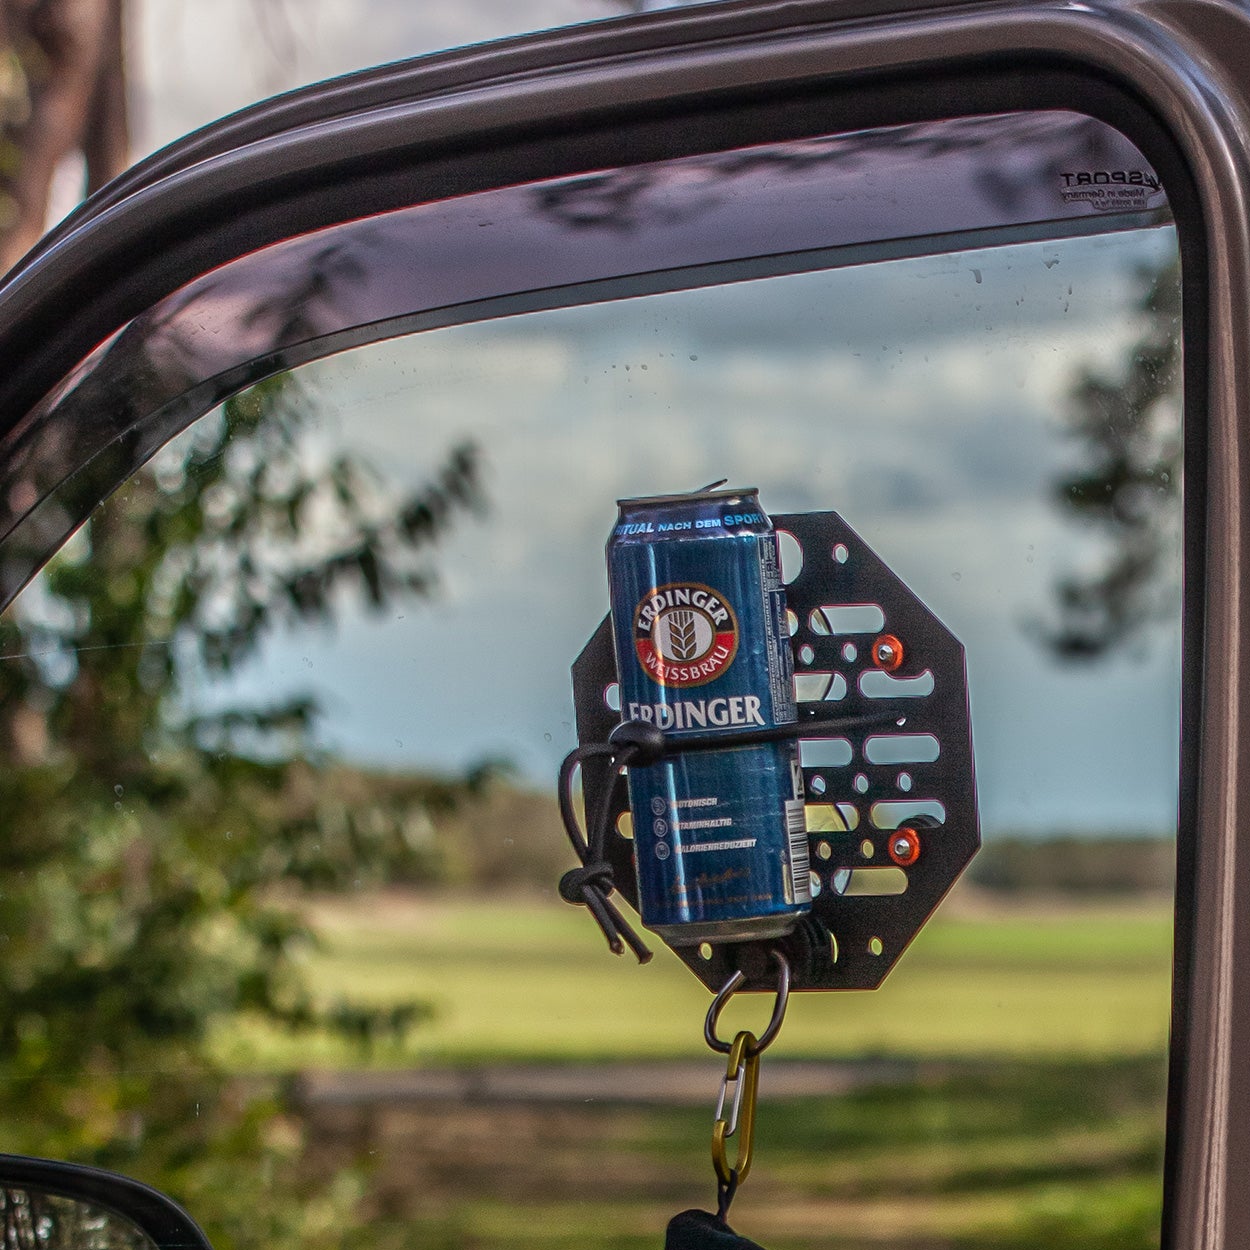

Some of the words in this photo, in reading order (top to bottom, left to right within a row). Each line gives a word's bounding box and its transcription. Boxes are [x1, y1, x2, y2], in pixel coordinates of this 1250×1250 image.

[658, 521, 692, 532] NACH
[695, 518, 721, 529] DEM
[637, 588, 729, 631] ERDINGER
[645, 645, 729, 681] WEISSBRÄU
